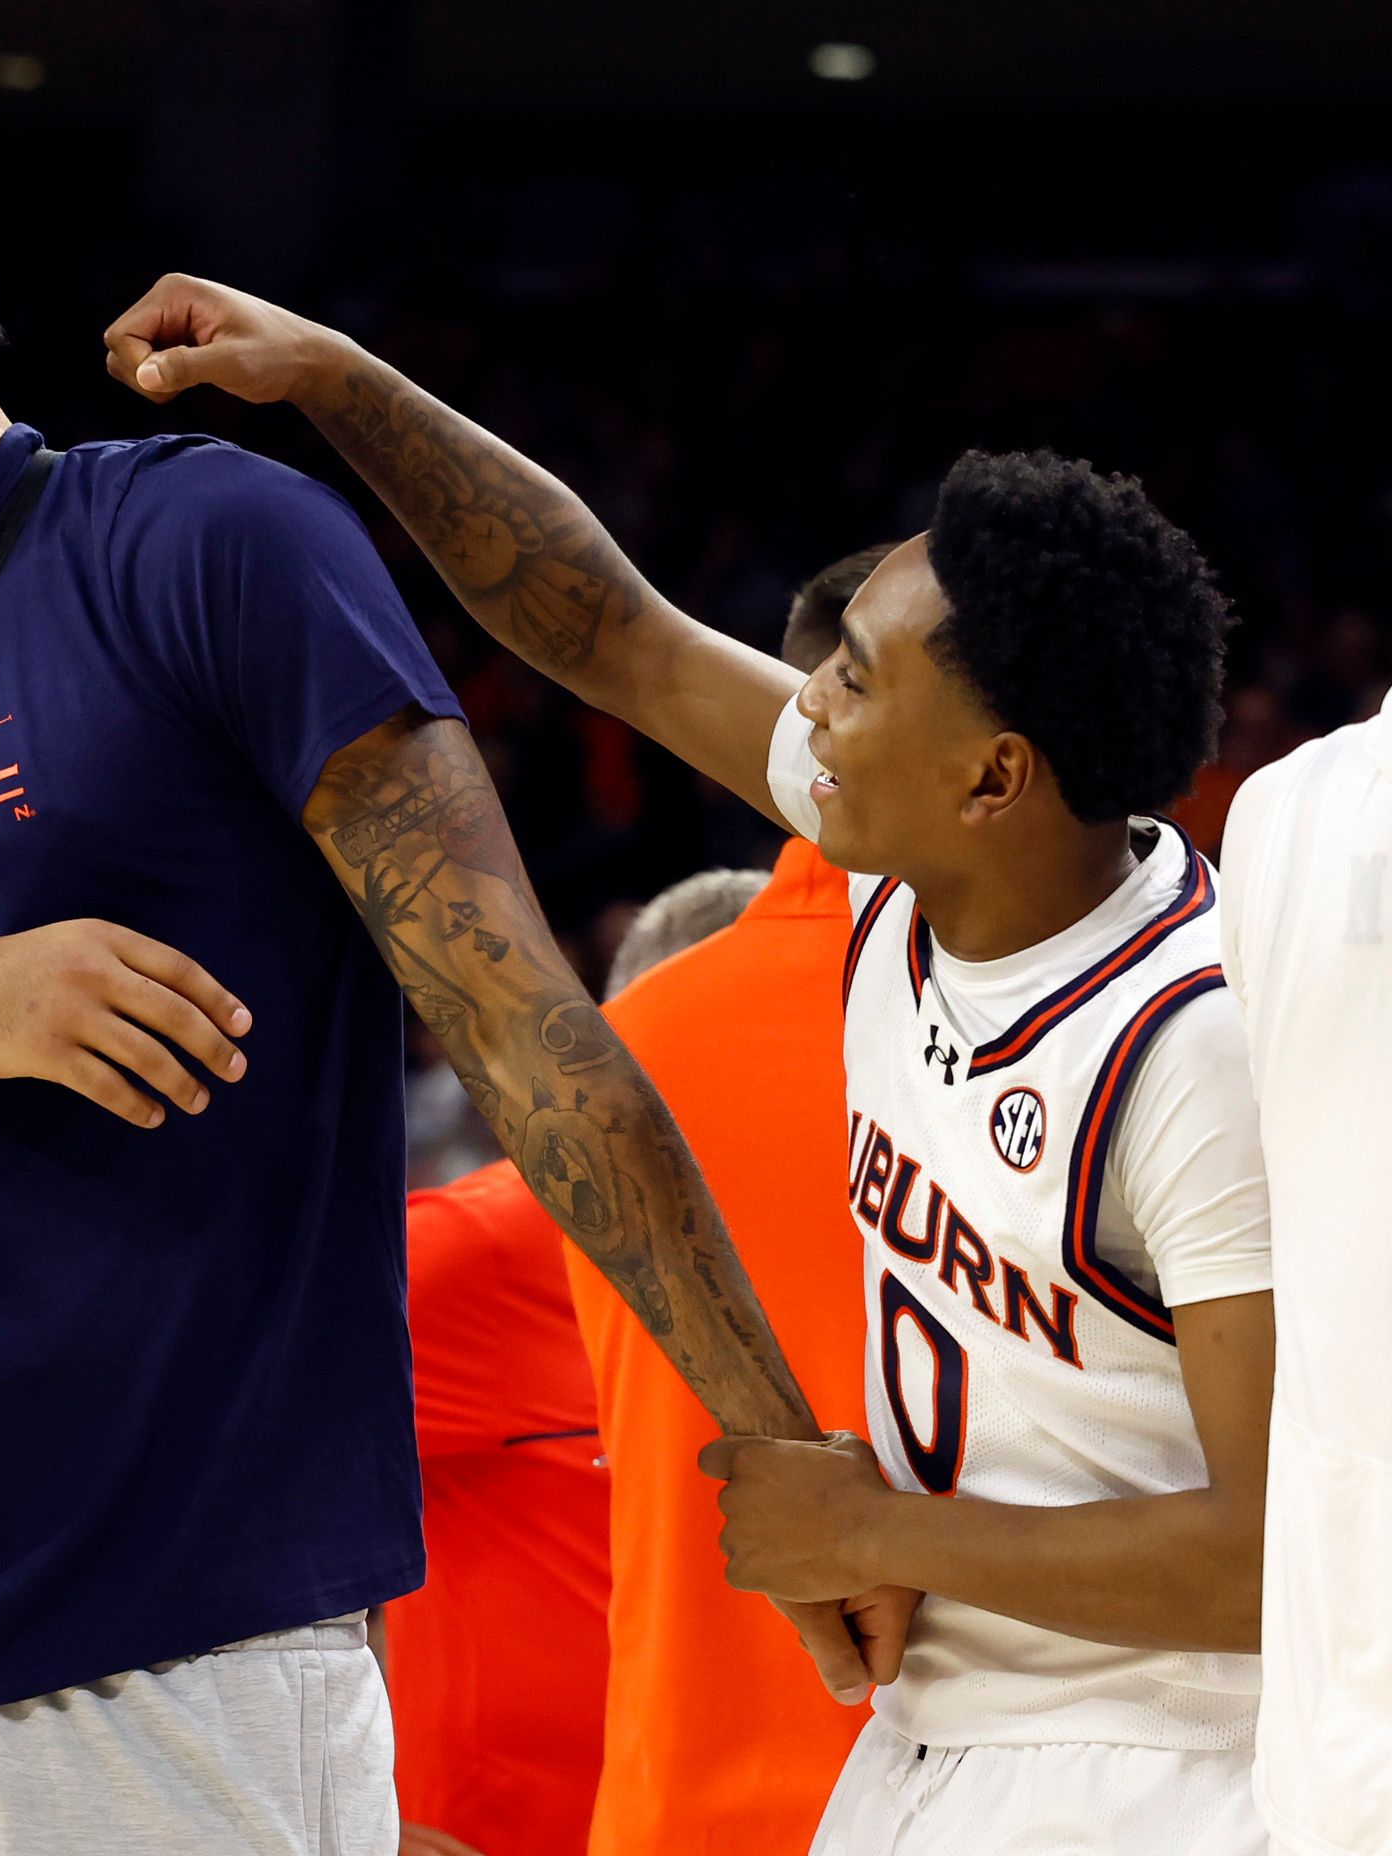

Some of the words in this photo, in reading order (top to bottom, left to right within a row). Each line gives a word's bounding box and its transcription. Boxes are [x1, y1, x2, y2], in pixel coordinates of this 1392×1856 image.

[849, 1109, 1084, 1371] UBURN
[994, 1091, 1042, 1168] SEC
[879, 1267, 969, 1498] 0
